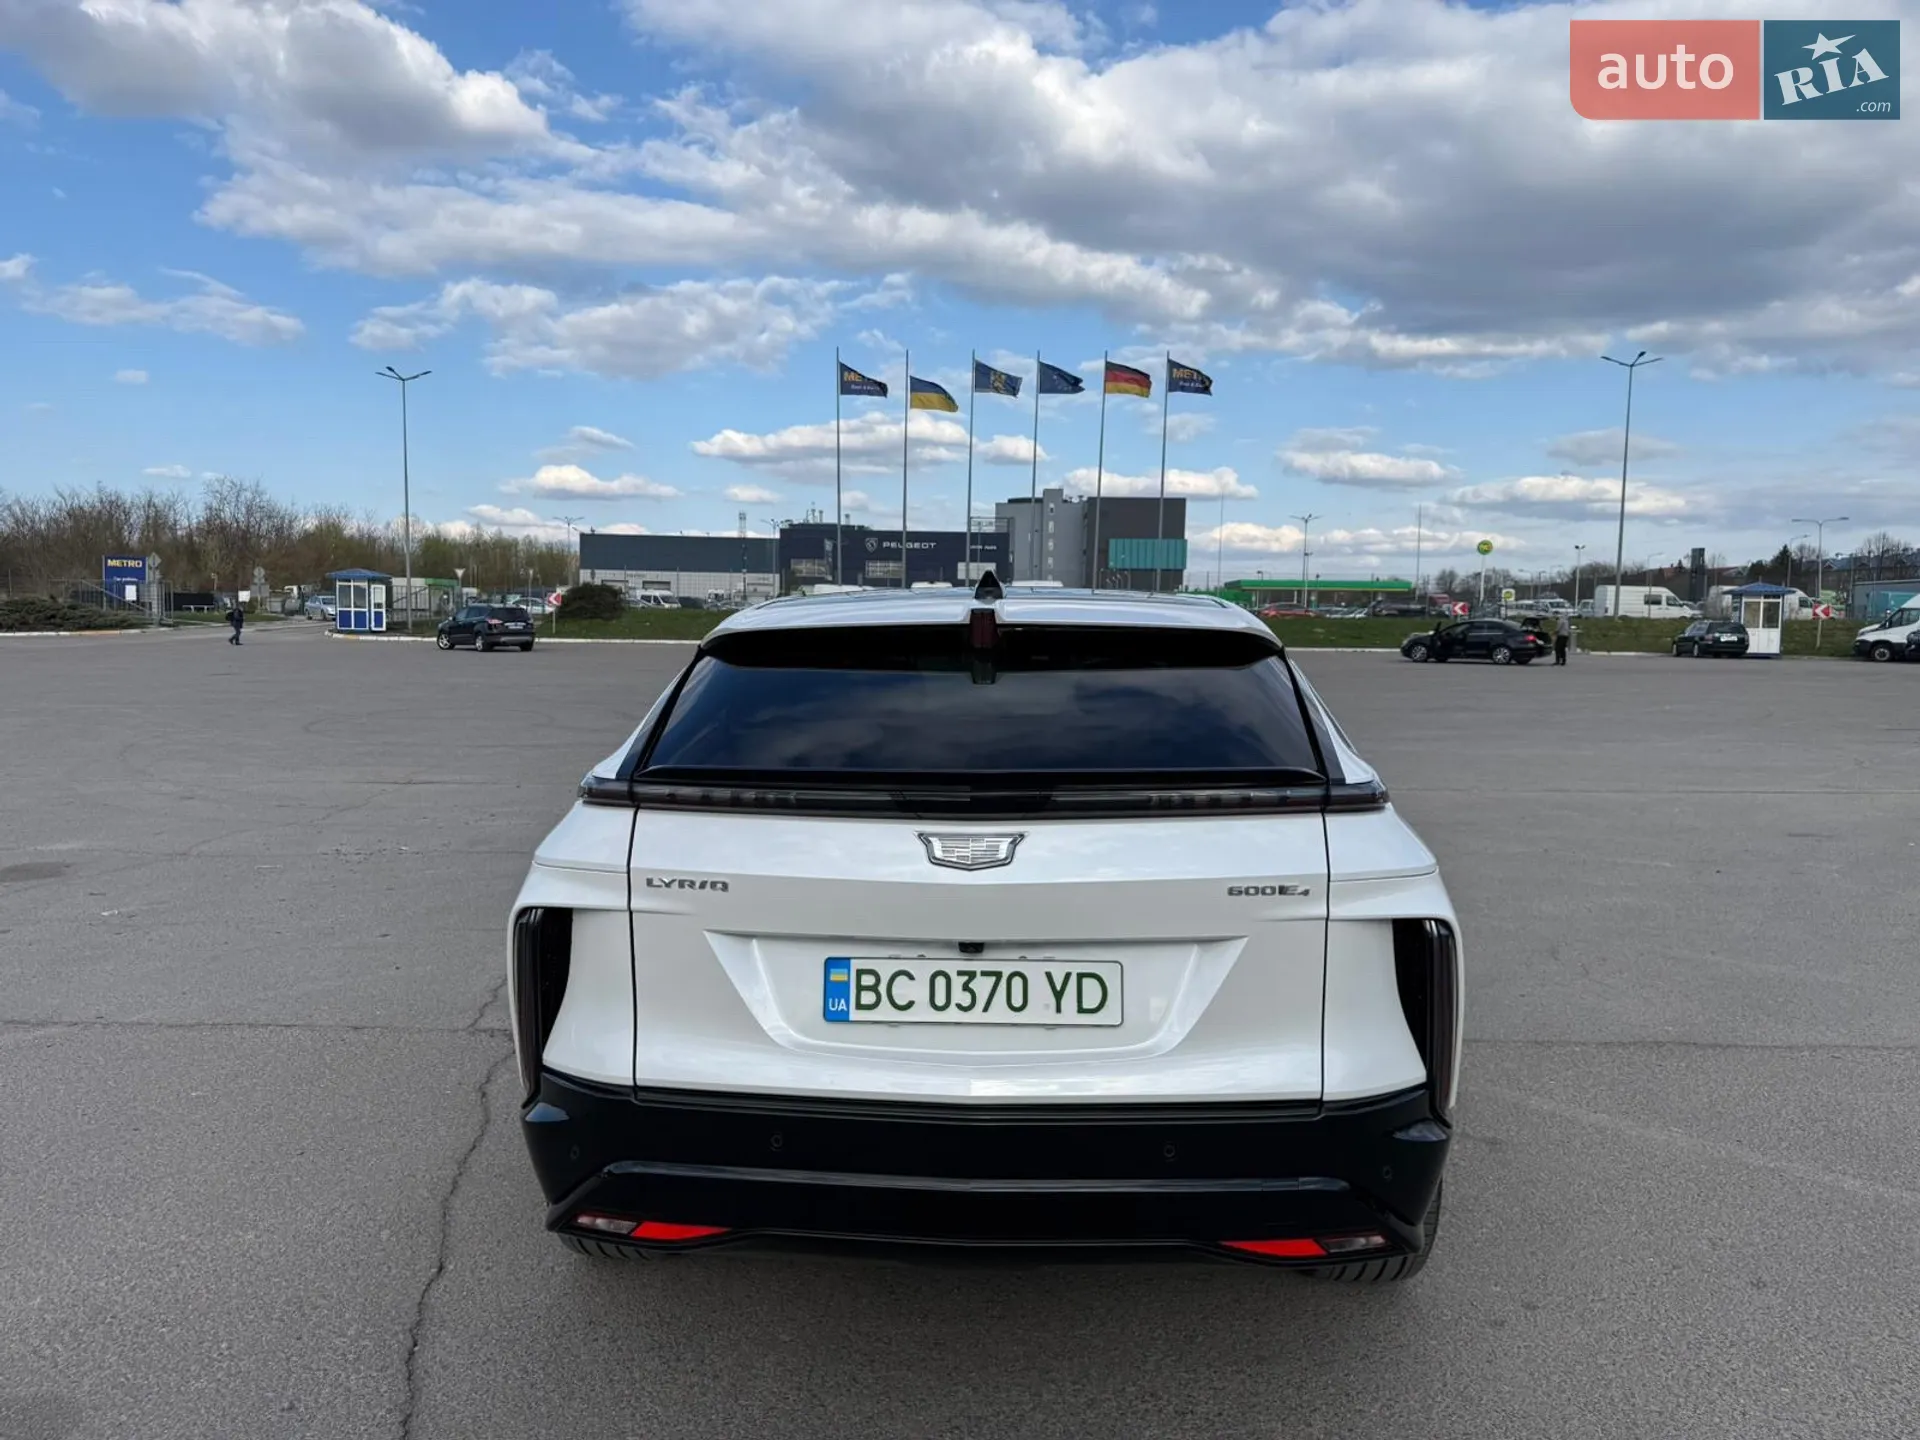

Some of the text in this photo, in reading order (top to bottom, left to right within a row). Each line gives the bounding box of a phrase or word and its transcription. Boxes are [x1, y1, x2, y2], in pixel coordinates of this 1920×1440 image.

[882, 541, 937, 549] PEUGEOT
[107, 559, 143, 568] METRO
[646, 878, 729, 893] LYRIQ
[855, 968, 1109, 1015] BC 0370 YD
[829, 998, 848, 1012] UA
